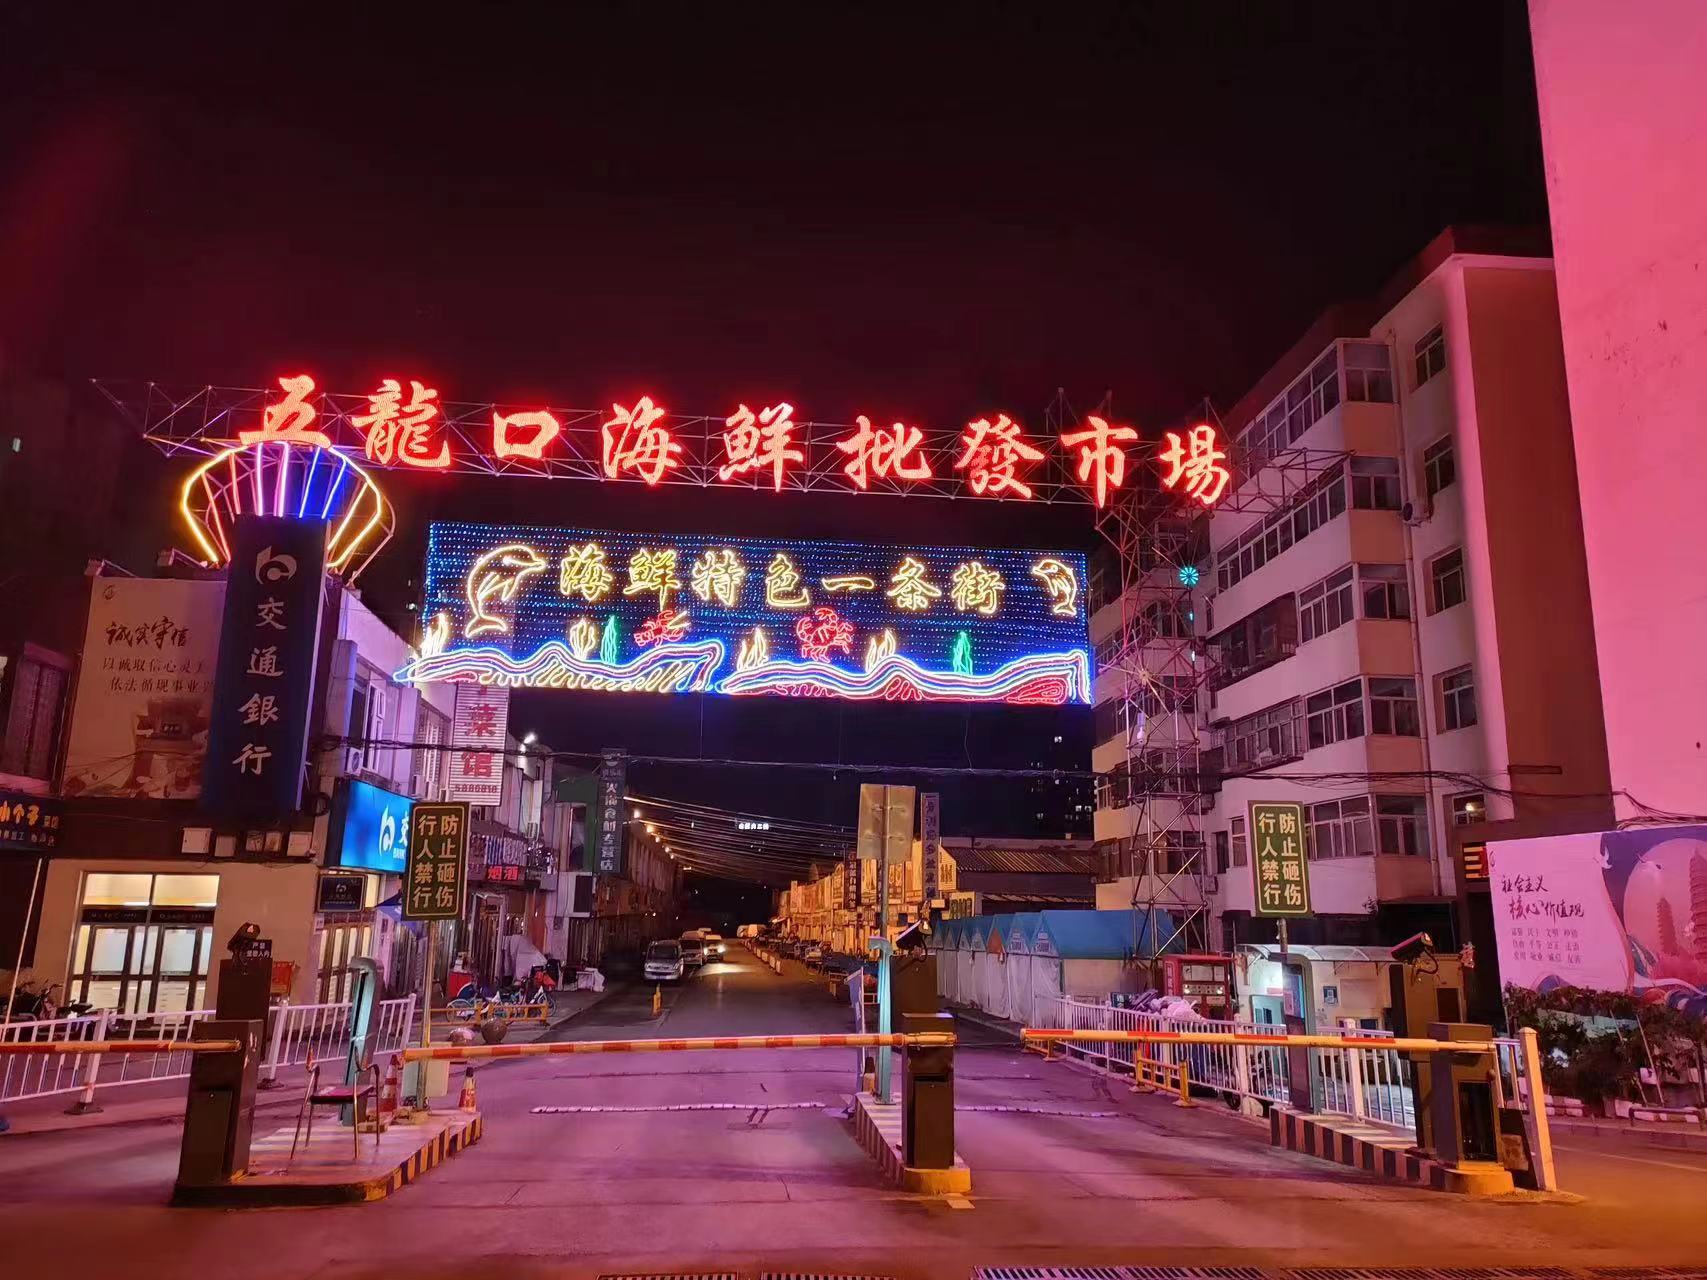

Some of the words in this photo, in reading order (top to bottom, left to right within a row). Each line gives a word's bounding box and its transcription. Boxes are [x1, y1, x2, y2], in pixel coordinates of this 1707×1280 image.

[239, 374, 1230, 507] 五龍口海鮮批發市場
[232, 597, 288, 776] 交通銀行
[461, 684, 498, 778] 菜馆
[413, 814, 437, 908] 行人禁行
[435, 814, 459, 908] 防止砸伤
[488, 866, 519, 881] 烟酒
[1258, 811, 1281, 905] 行人禁行
[1279, 812, 1302, 906] 防止砸伤
[1501, 873, 1549, 894] 社会主义
[1508, 894, 1585, 926] 核心价值观
